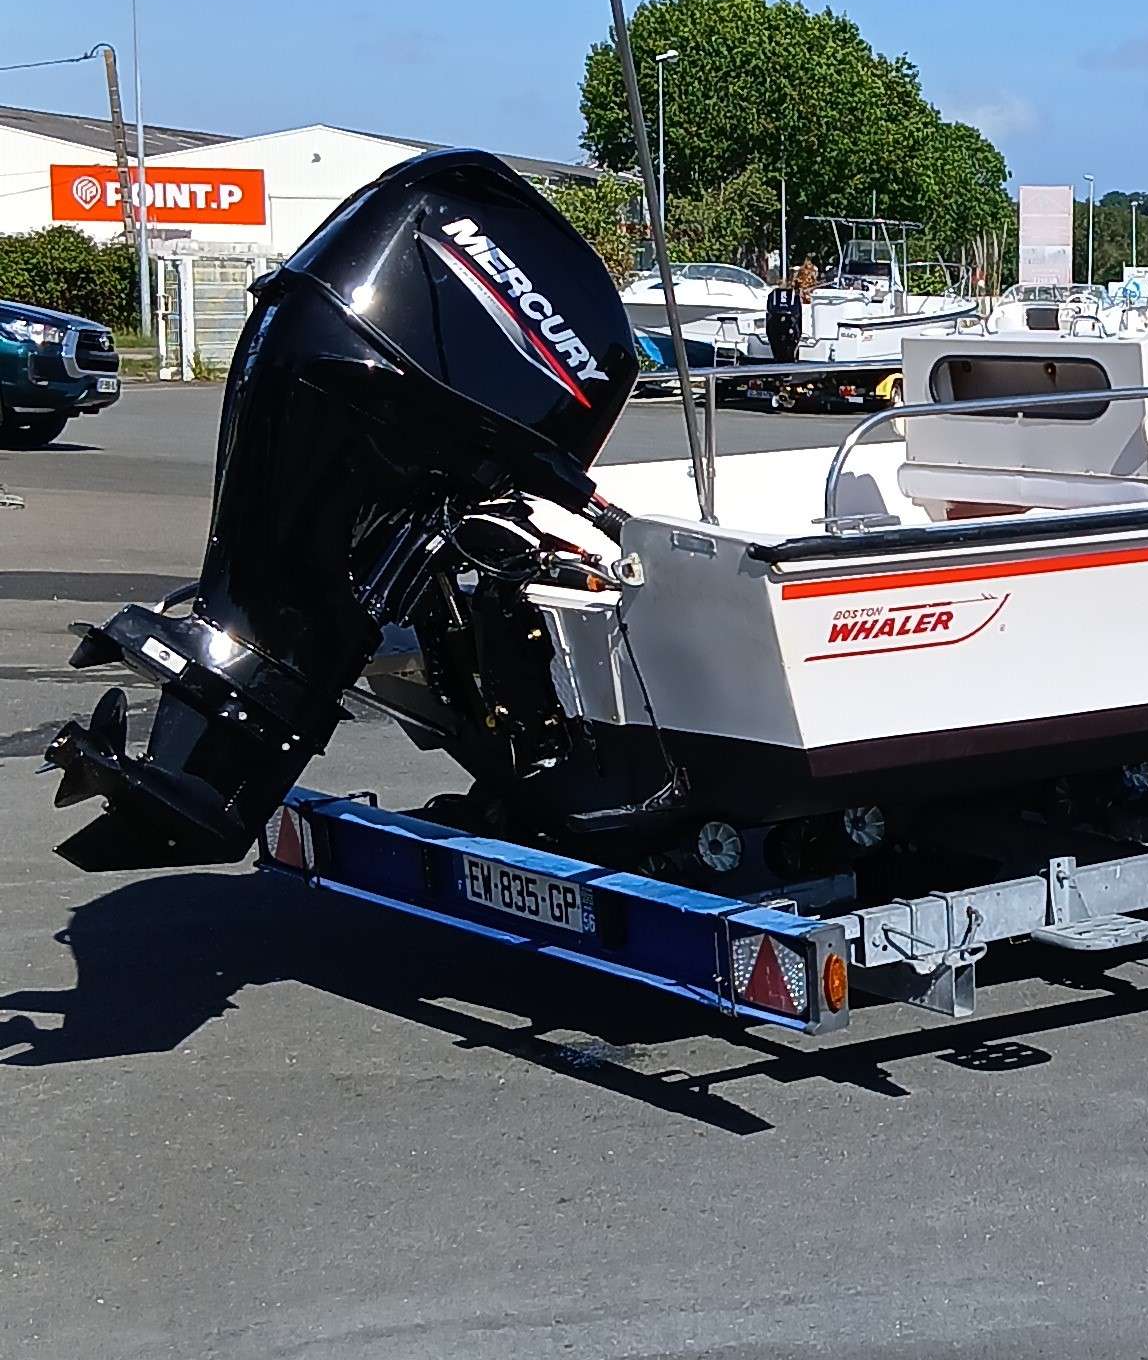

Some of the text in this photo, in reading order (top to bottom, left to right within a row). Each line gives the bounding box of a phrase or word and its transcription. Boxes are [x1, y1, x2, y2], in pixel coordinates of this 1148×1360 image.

[442, 218, 610, 381] MERCURY
[827, 610, 954, 643] WHALER
[833, 606, 884, 621] BOSTON
